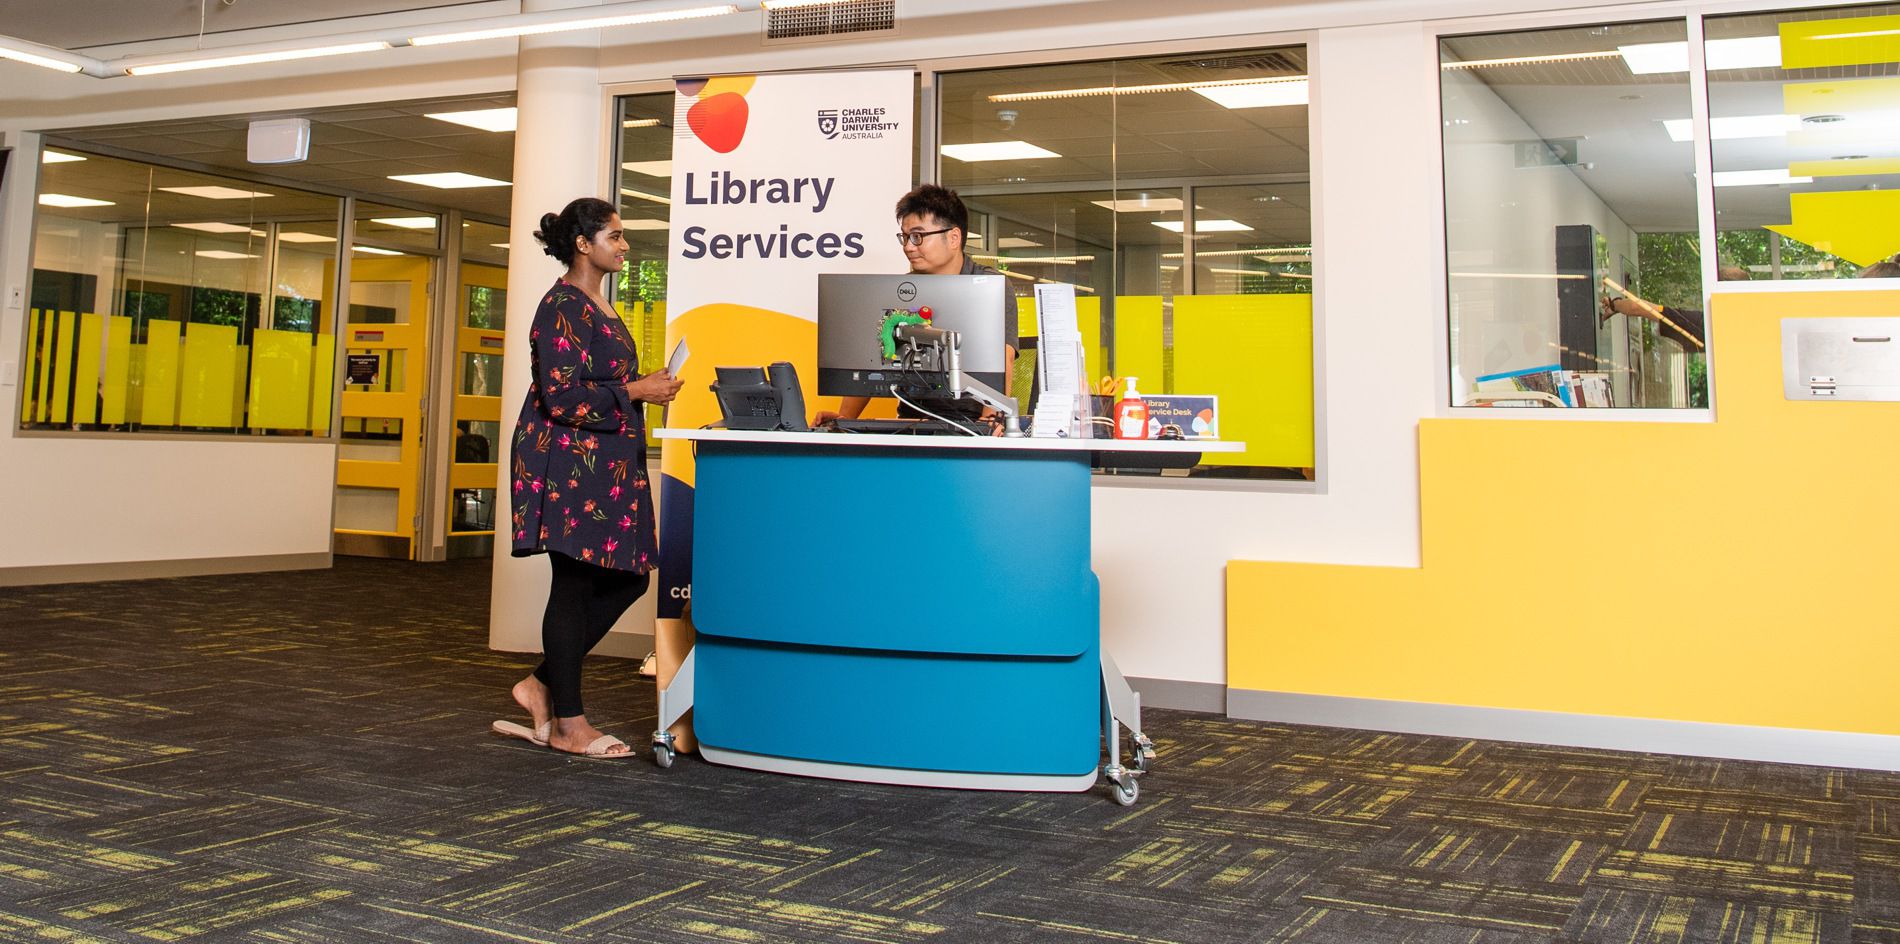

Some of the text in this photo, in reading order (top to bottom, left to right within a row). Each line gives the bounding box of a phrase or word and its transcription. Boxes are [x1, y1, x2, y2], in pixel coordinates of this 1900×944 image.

[842, 108, 885, 116] CHARLES
[842, 122, 899, 131] UNIVERSITY
[842, 132, 883, 140] AUSTRALIA
[685, 171, 835, 213] Library
[682, 224, 864, 259] Services
[1148, 408, 1192, 416] ervice Desk
